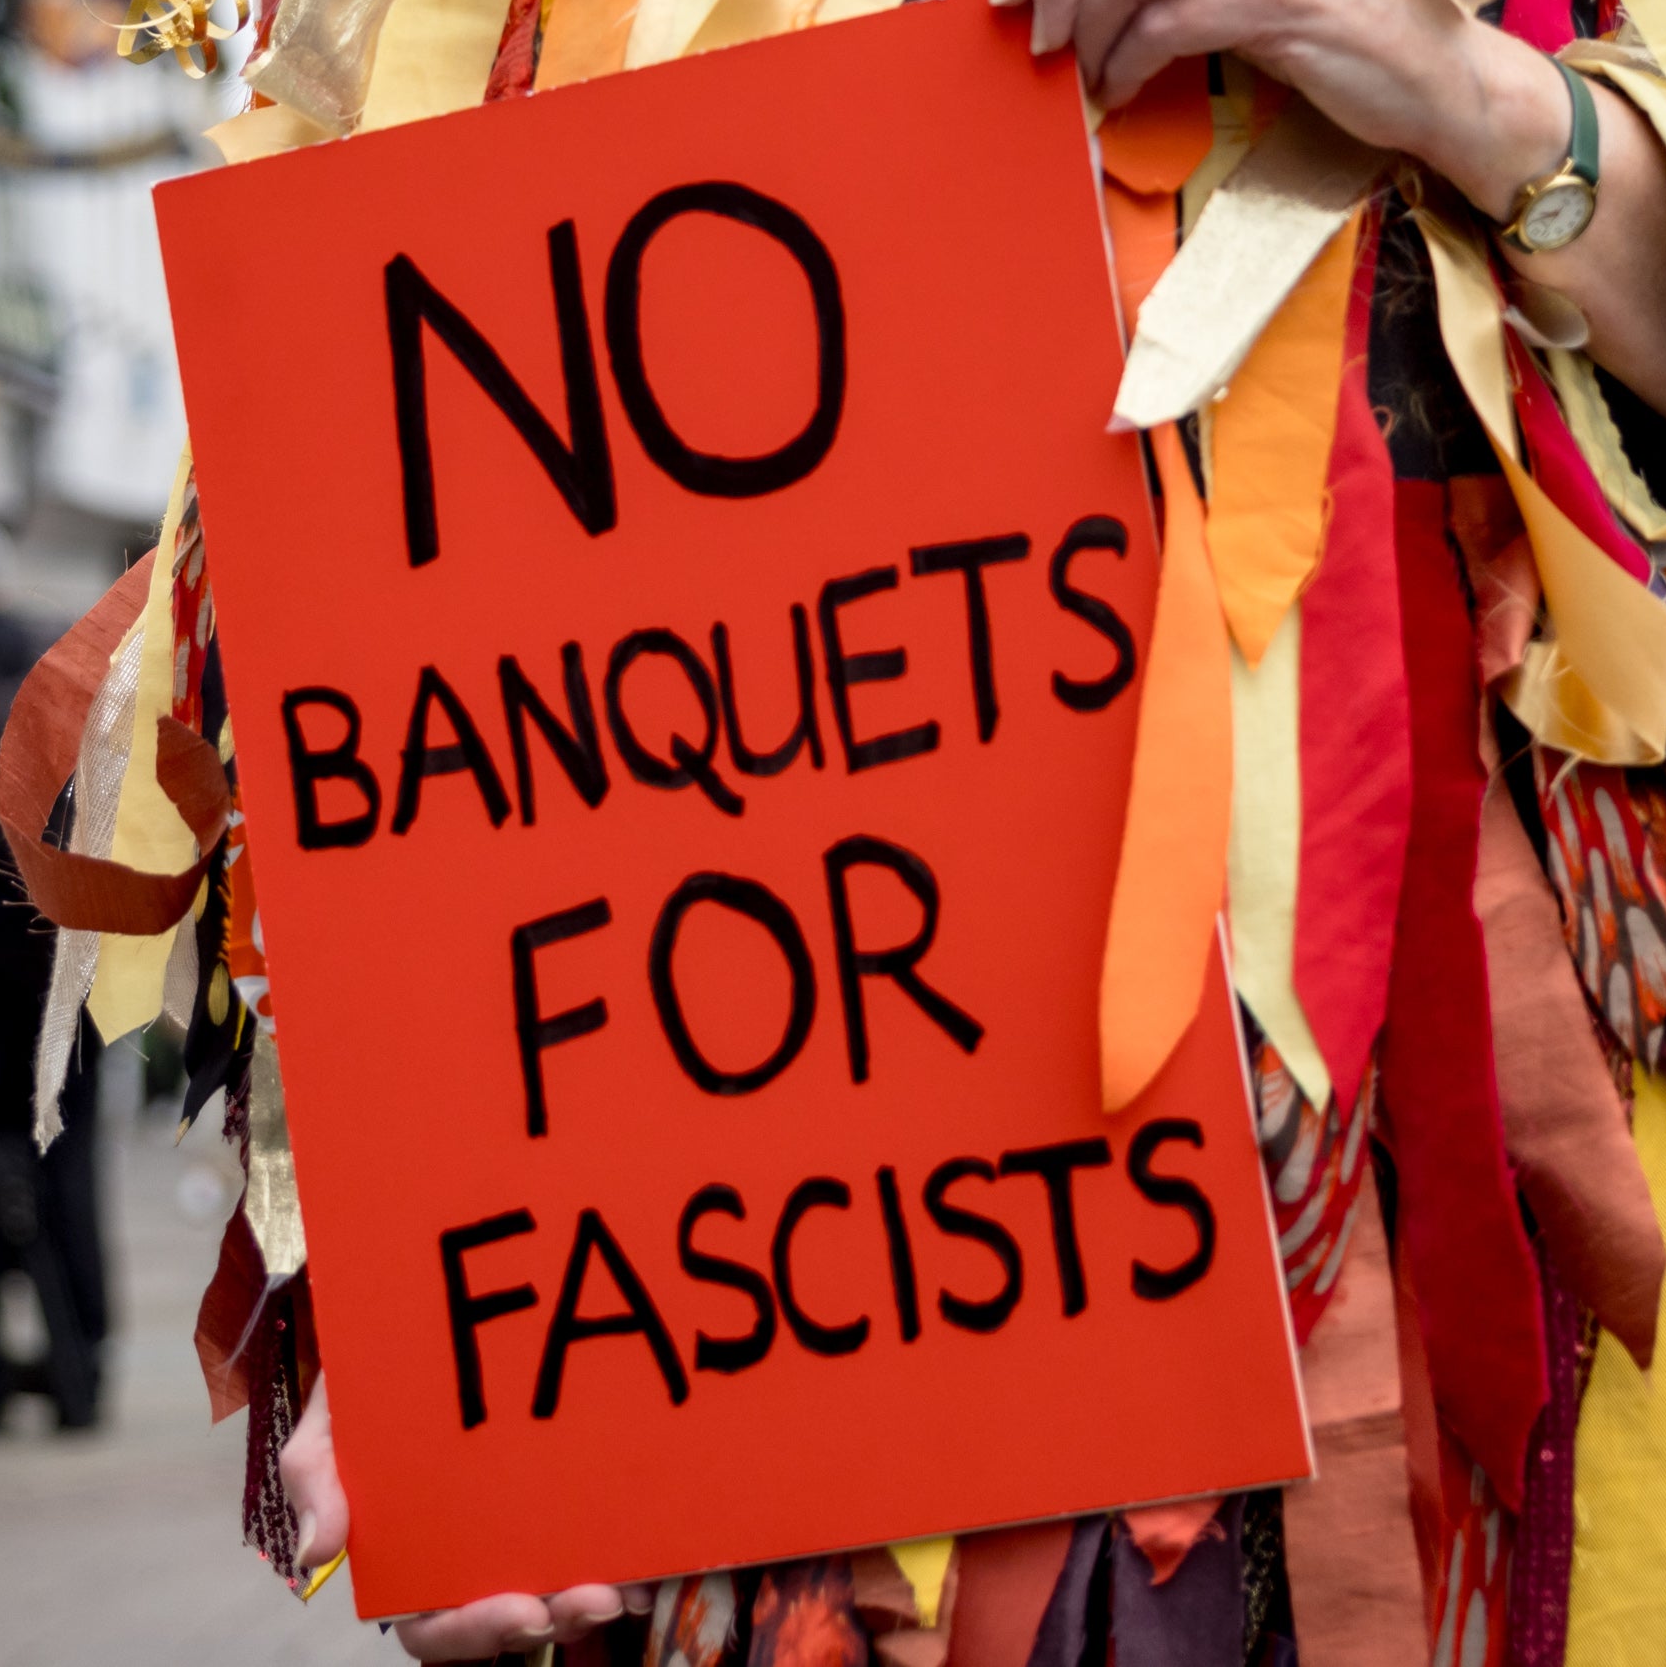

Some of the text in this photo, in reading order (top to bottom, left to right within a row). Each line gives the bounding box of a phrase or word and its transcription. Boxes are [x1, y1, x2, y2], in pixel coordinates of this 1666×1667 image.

[384, 180, 847, 568] NO
[282, 515, 1137, 850] BANQUETS
[511, 834, 985, 1138] FOR
[439, 1118, 1217, 1431] FASCISTS
